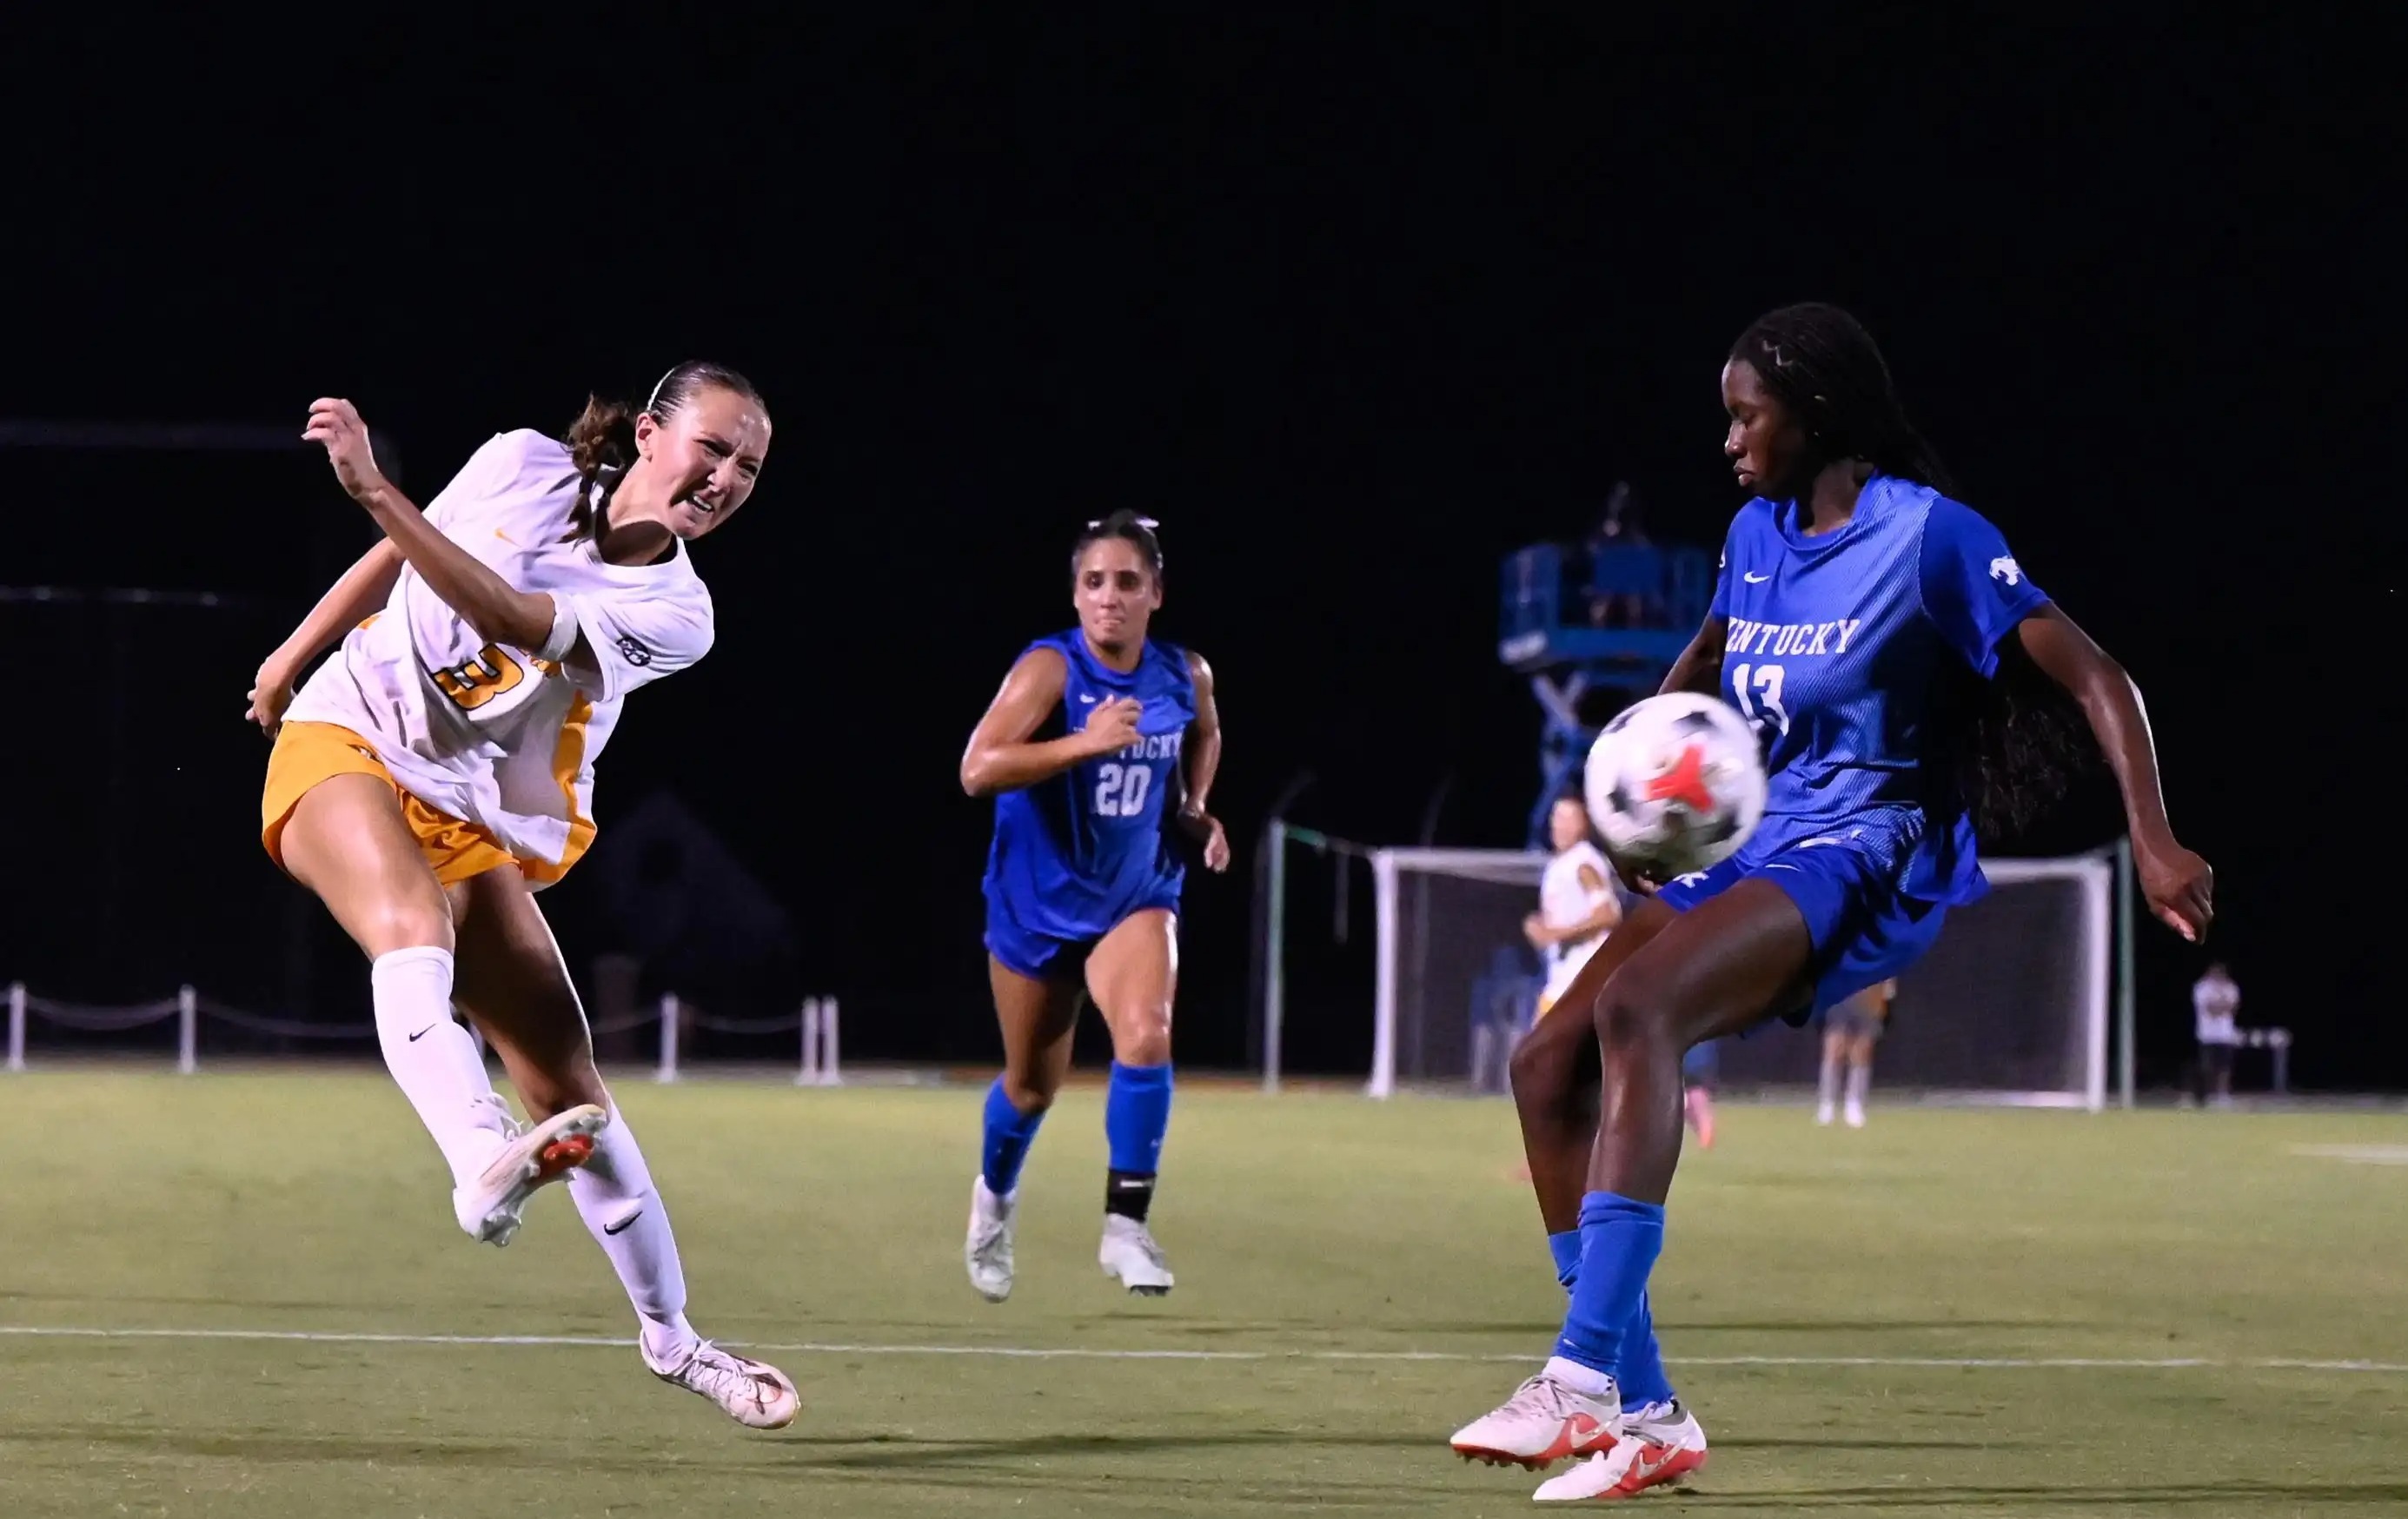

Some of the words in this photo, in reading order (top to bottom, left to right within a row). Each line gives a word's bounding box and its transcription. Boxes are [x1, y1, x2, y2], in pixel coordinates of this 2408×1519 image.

[434, 642, 524, 711] 3
[1733, 663, 1789, 736] 13
[1096, 763, 1151, 816] 20
